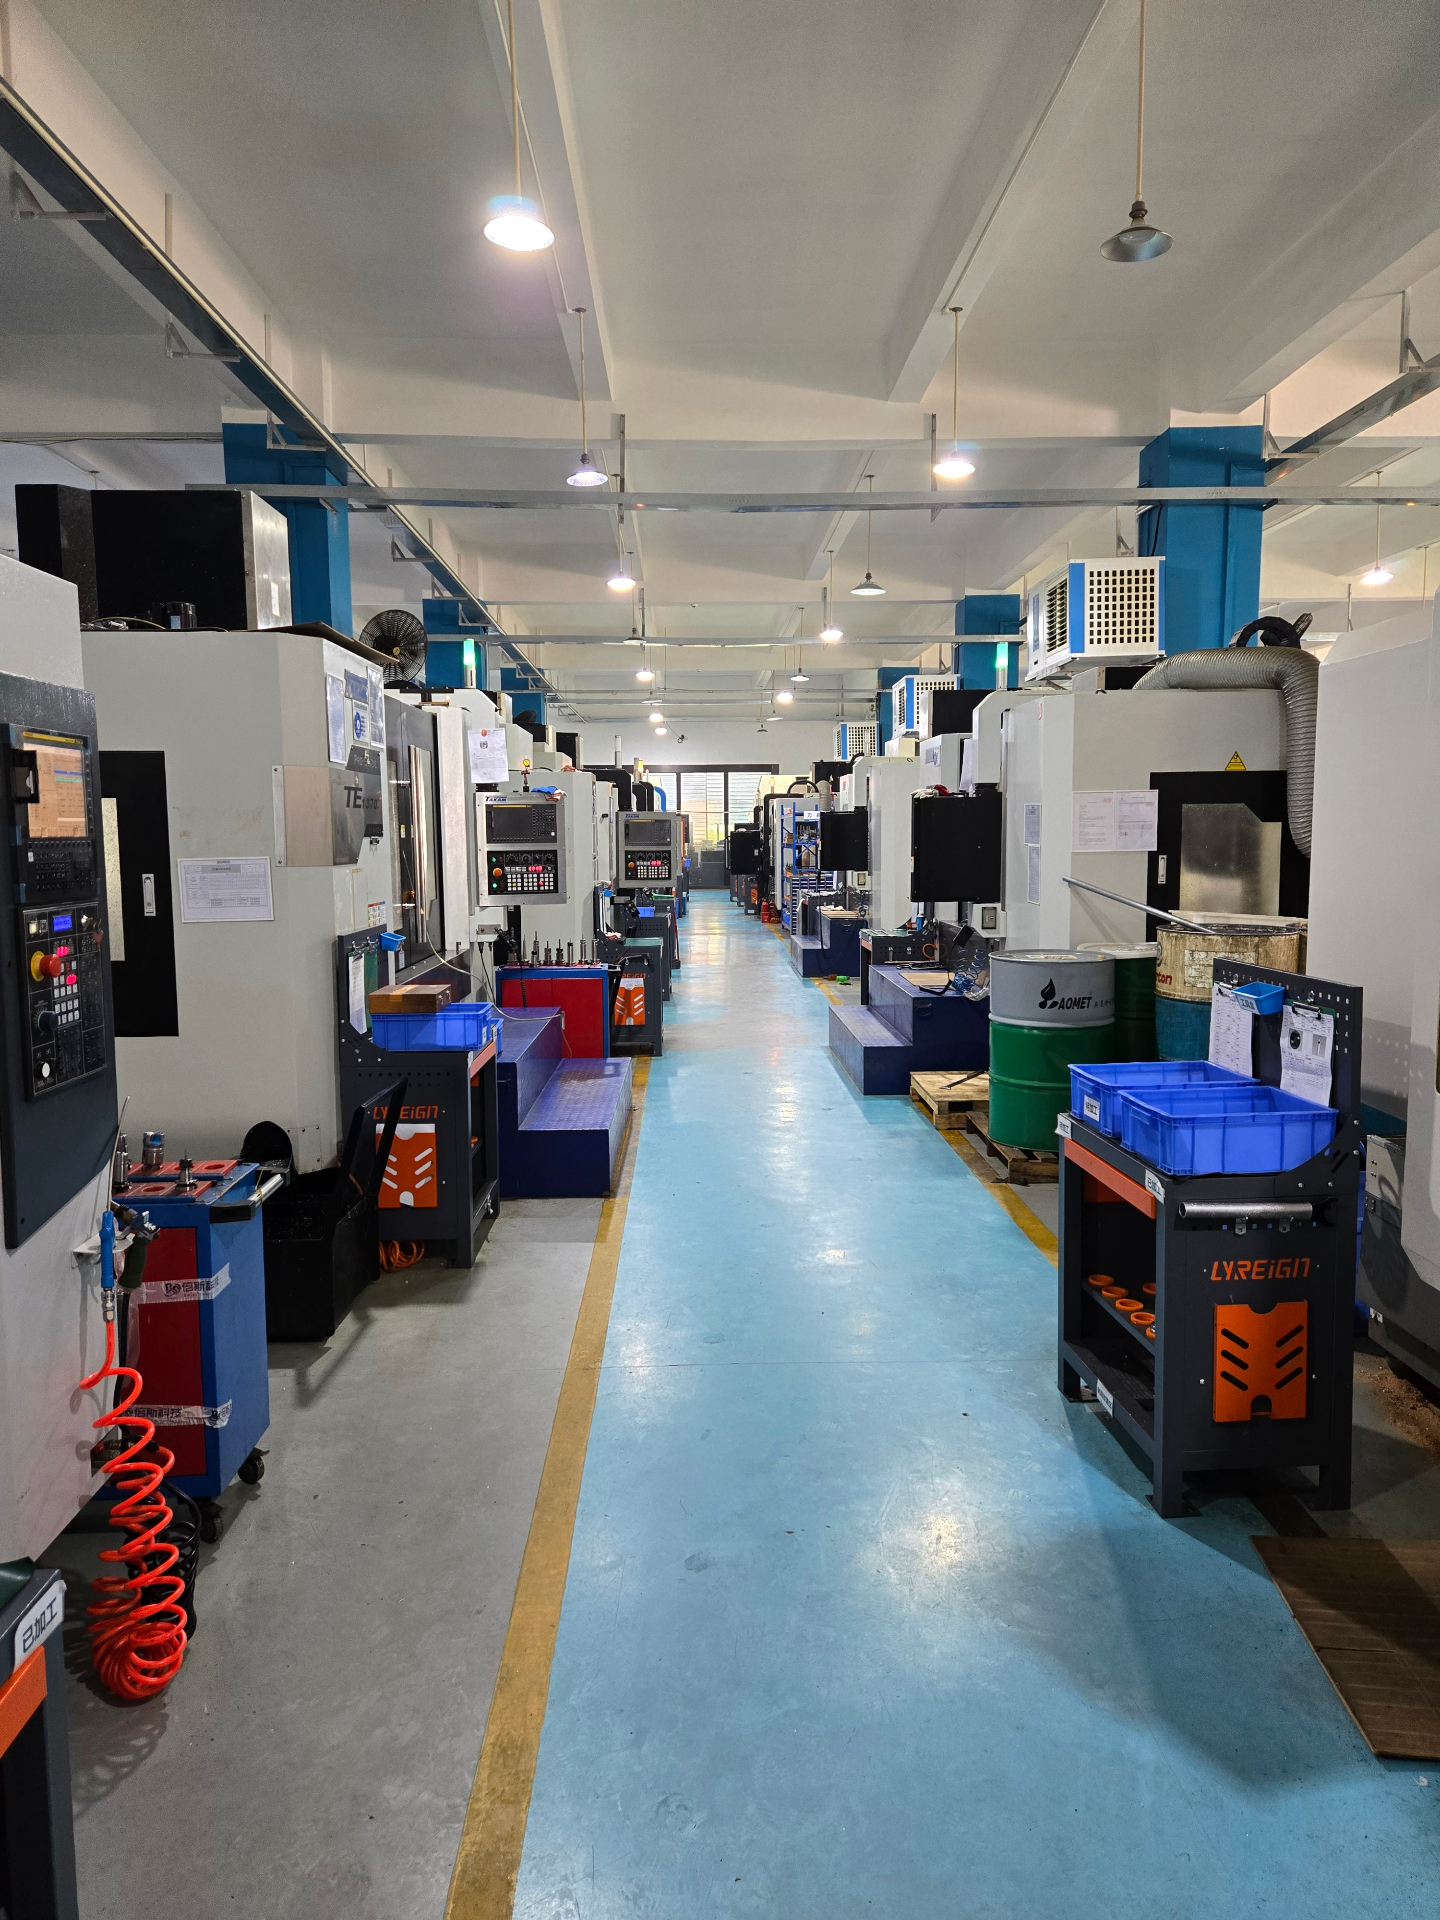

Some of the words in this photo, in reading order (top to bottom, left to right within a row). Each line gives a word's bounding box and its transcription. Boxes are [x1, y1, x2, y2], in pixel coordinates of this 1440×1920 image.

[1058, 997, 1092, 1010] AOMET
[22, 1596, 58, 1654] 已加工
